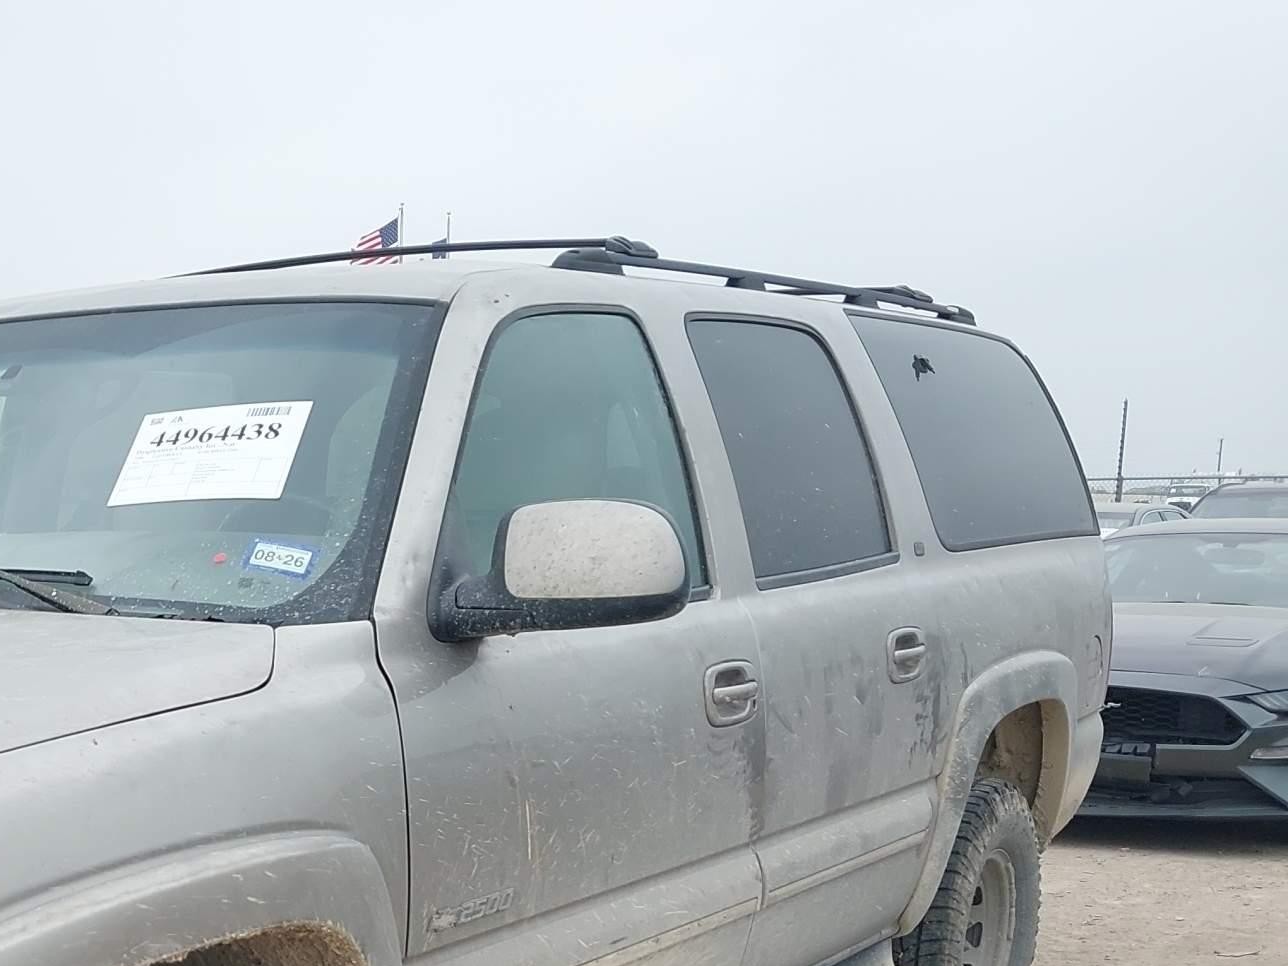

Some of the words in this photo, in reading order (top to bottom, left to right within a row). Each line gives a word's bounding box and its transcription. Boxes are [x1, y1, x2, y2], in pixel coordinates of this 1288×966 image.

[150, 422, 283, 448] 44964438
[254, 549, 276, 562] 08
[283, 554, 305, 567] 26
[457, 887, 515, 924] 2500
